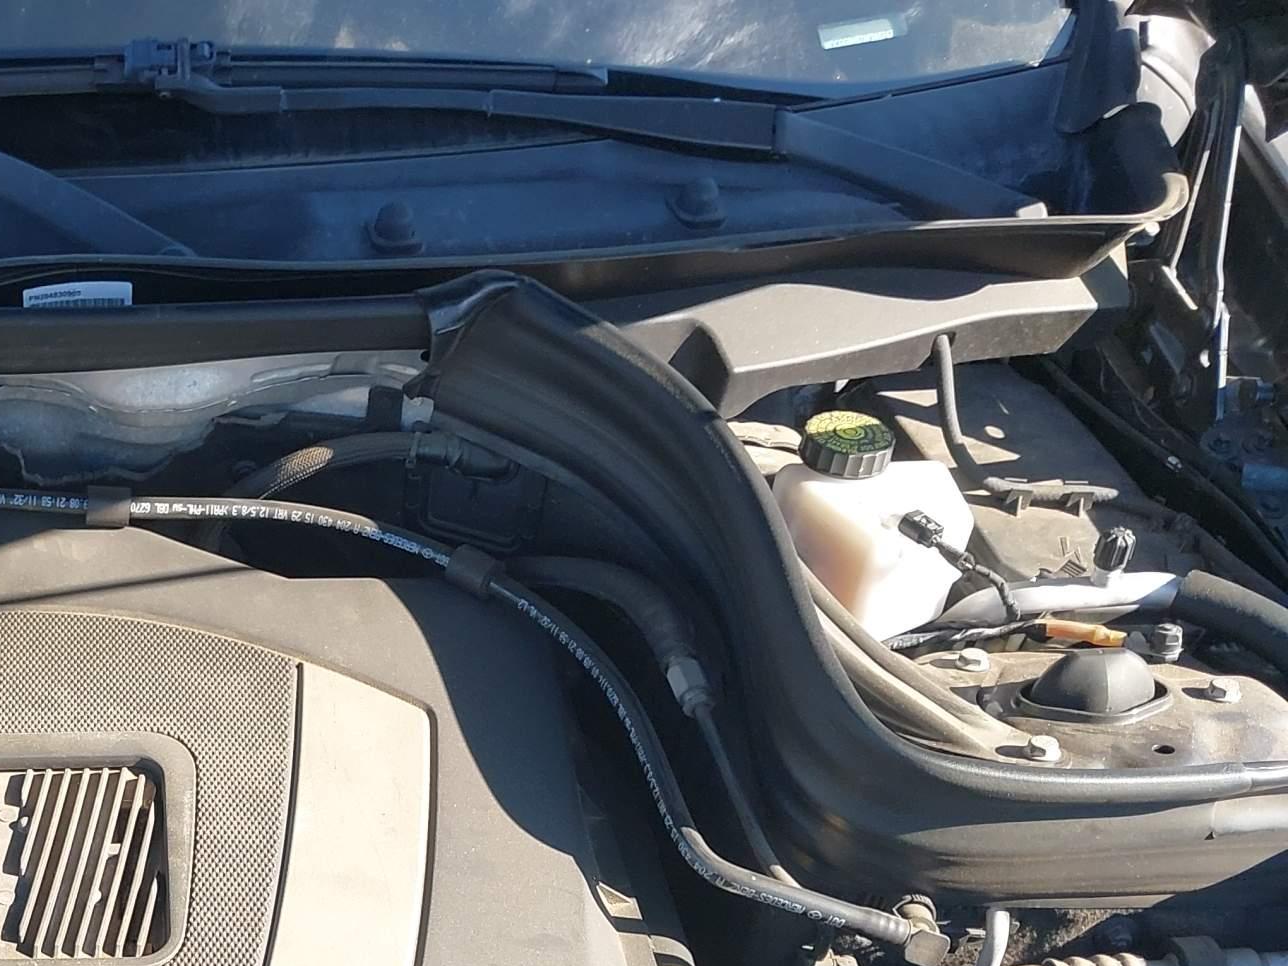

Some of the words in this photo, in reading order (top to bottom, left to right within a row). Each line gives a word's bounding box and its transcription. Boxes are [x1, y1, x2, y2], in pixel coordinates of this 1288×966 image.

[231, 504, 269, 518] 12.5/8.3
[273, 507, 288, 520] VRT
[317, 514, 333, 528] 430
[335, 518, 351, 532] 204
[361, 525, 422, 555] MERCEDES-BENZ
[726, 881, 806, 914] MERCEDES-BENZ
